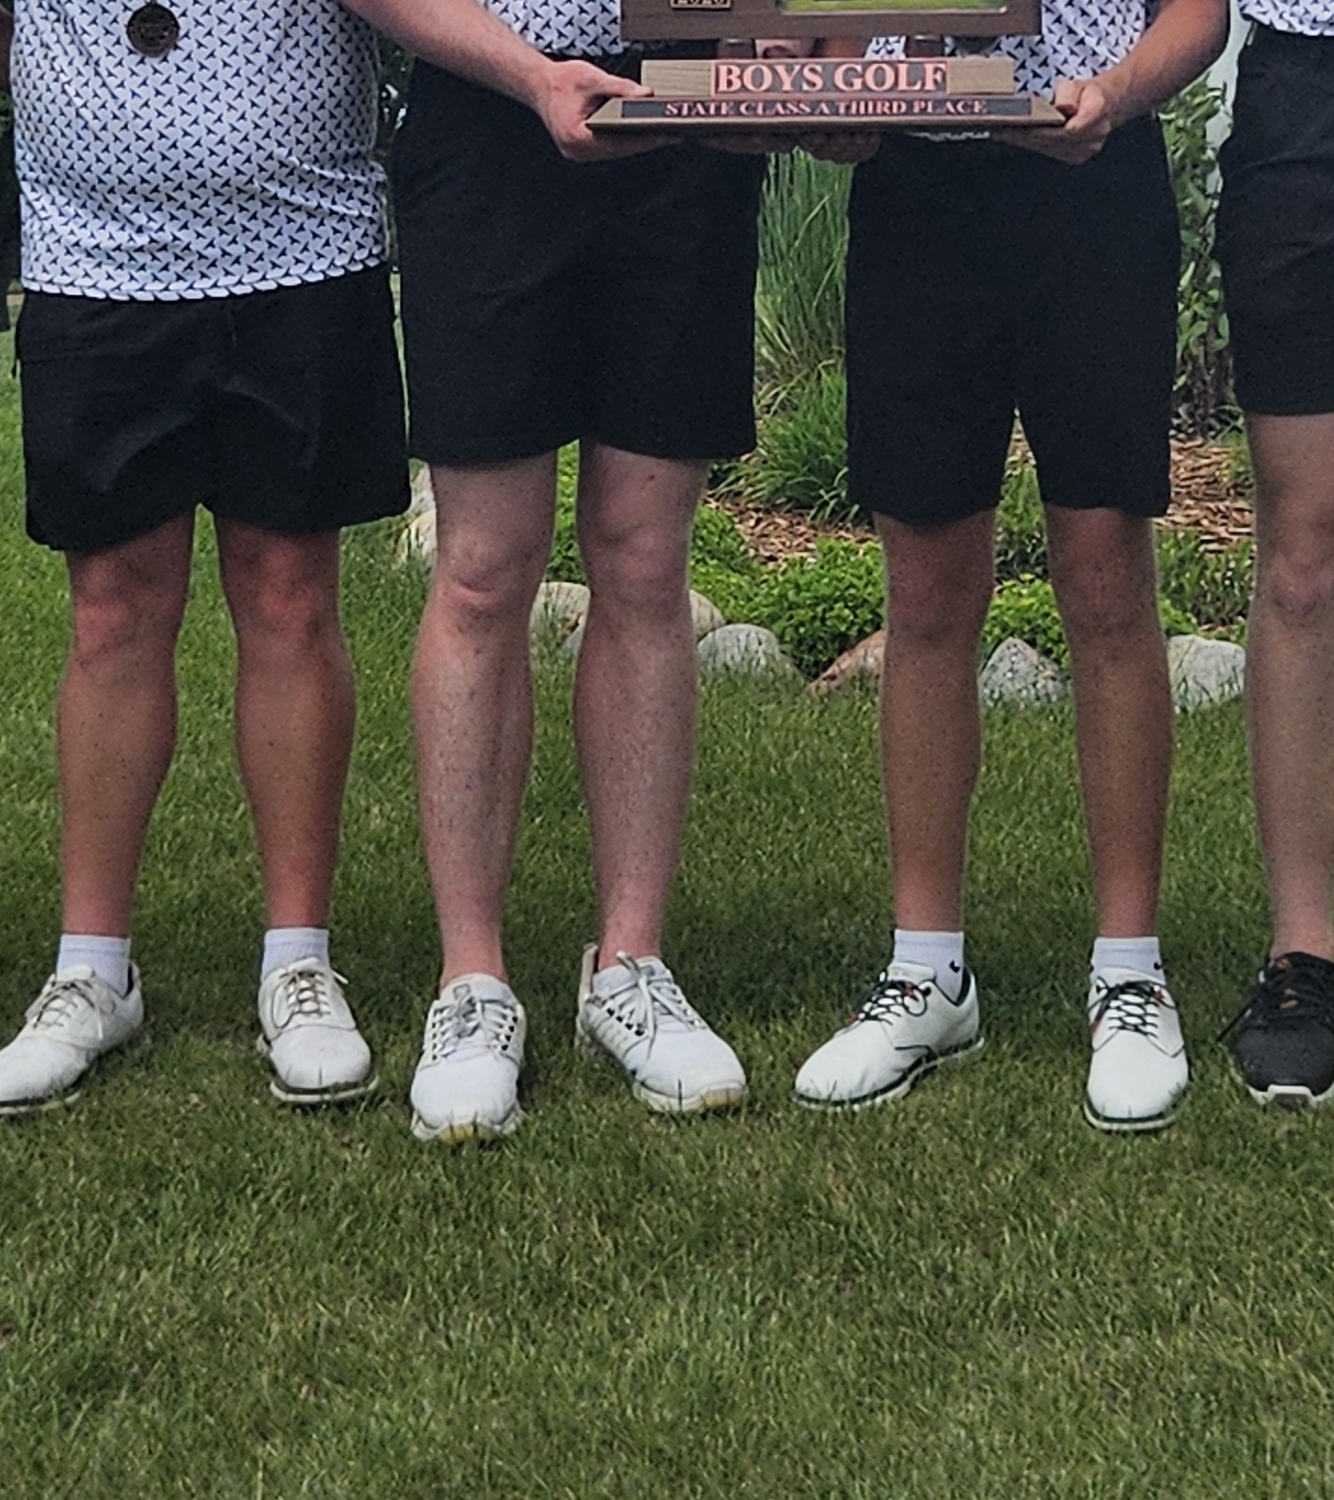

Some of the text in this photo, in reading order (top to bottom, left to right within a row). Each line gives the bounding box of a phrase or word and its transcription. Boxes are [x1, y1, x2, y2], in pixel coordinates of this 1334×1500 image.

[717, 63, 948, 93] BOYS GOLF
[665, 100, 987, 117] STATE CLASS A THIRD PLACE
